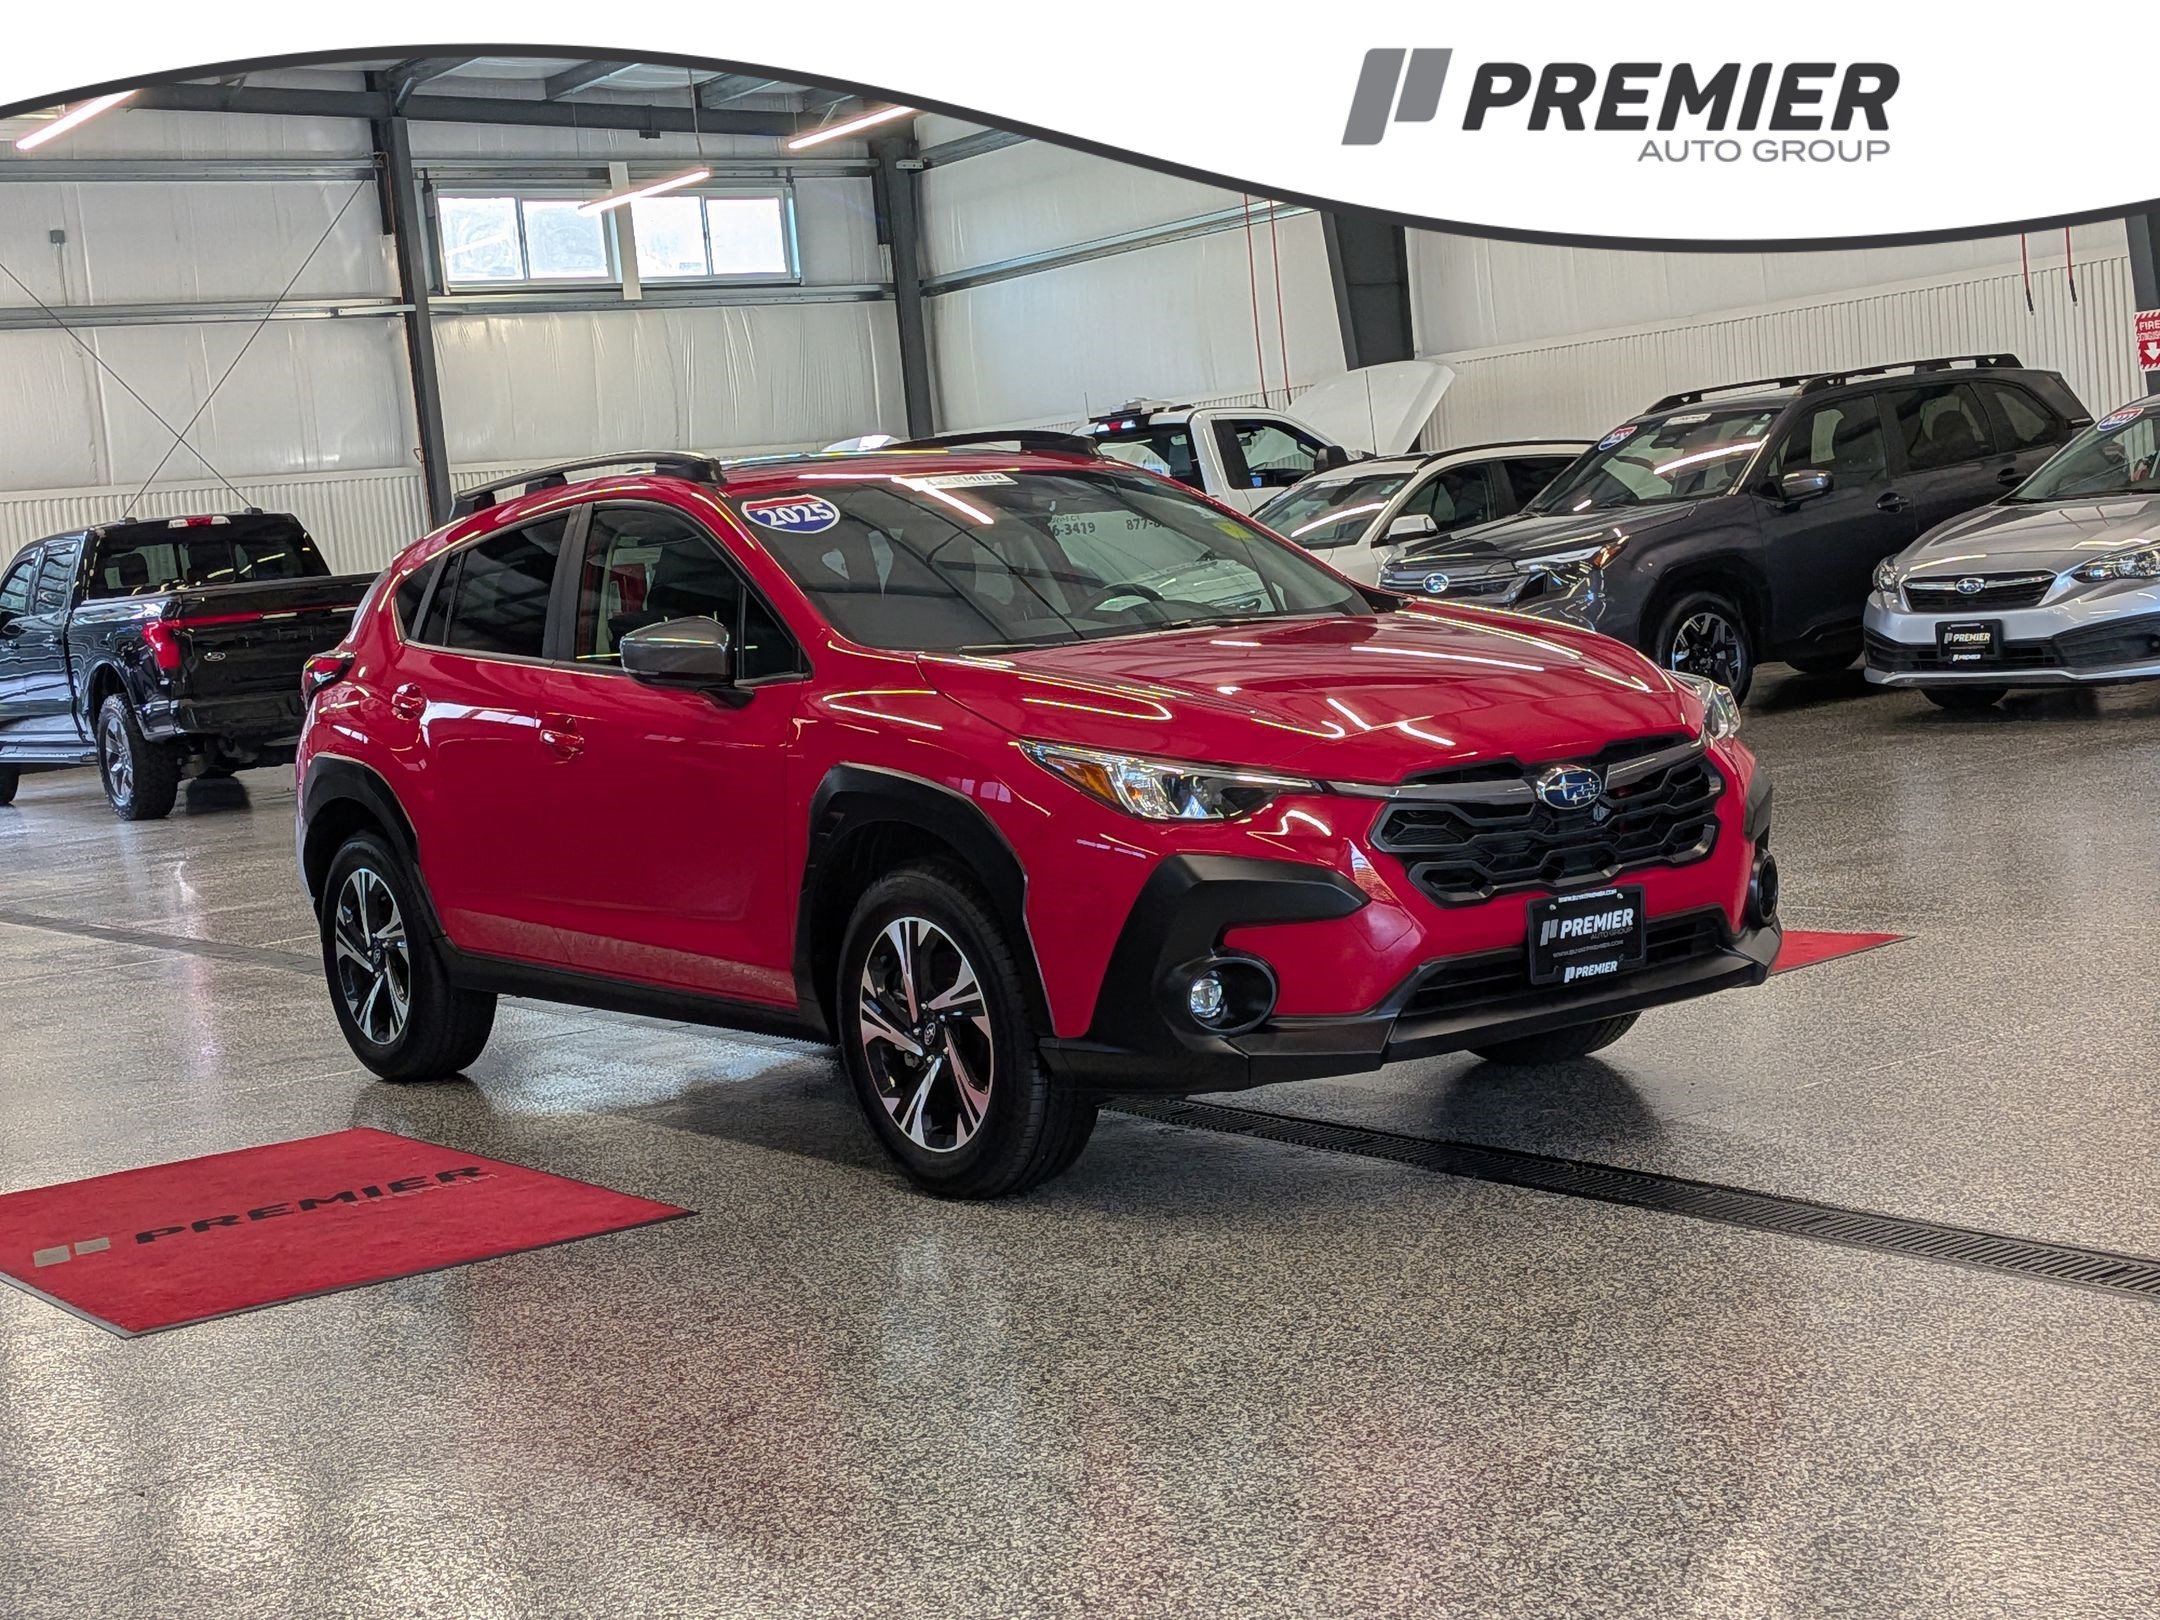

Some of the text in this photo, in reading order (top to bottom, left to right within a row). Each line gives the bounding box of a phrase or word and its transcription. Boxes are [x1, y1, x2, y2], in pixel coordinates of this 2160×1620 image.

[757, 503, 835, 526] 2025
[1560, 908, 1634, 939] PREMIER
[1590, 926, 1634, 940] AUTO GROUP
[1575, 960, 1618, 979] PREMIER
[135, 1166, 482, 1244] PREMIER
